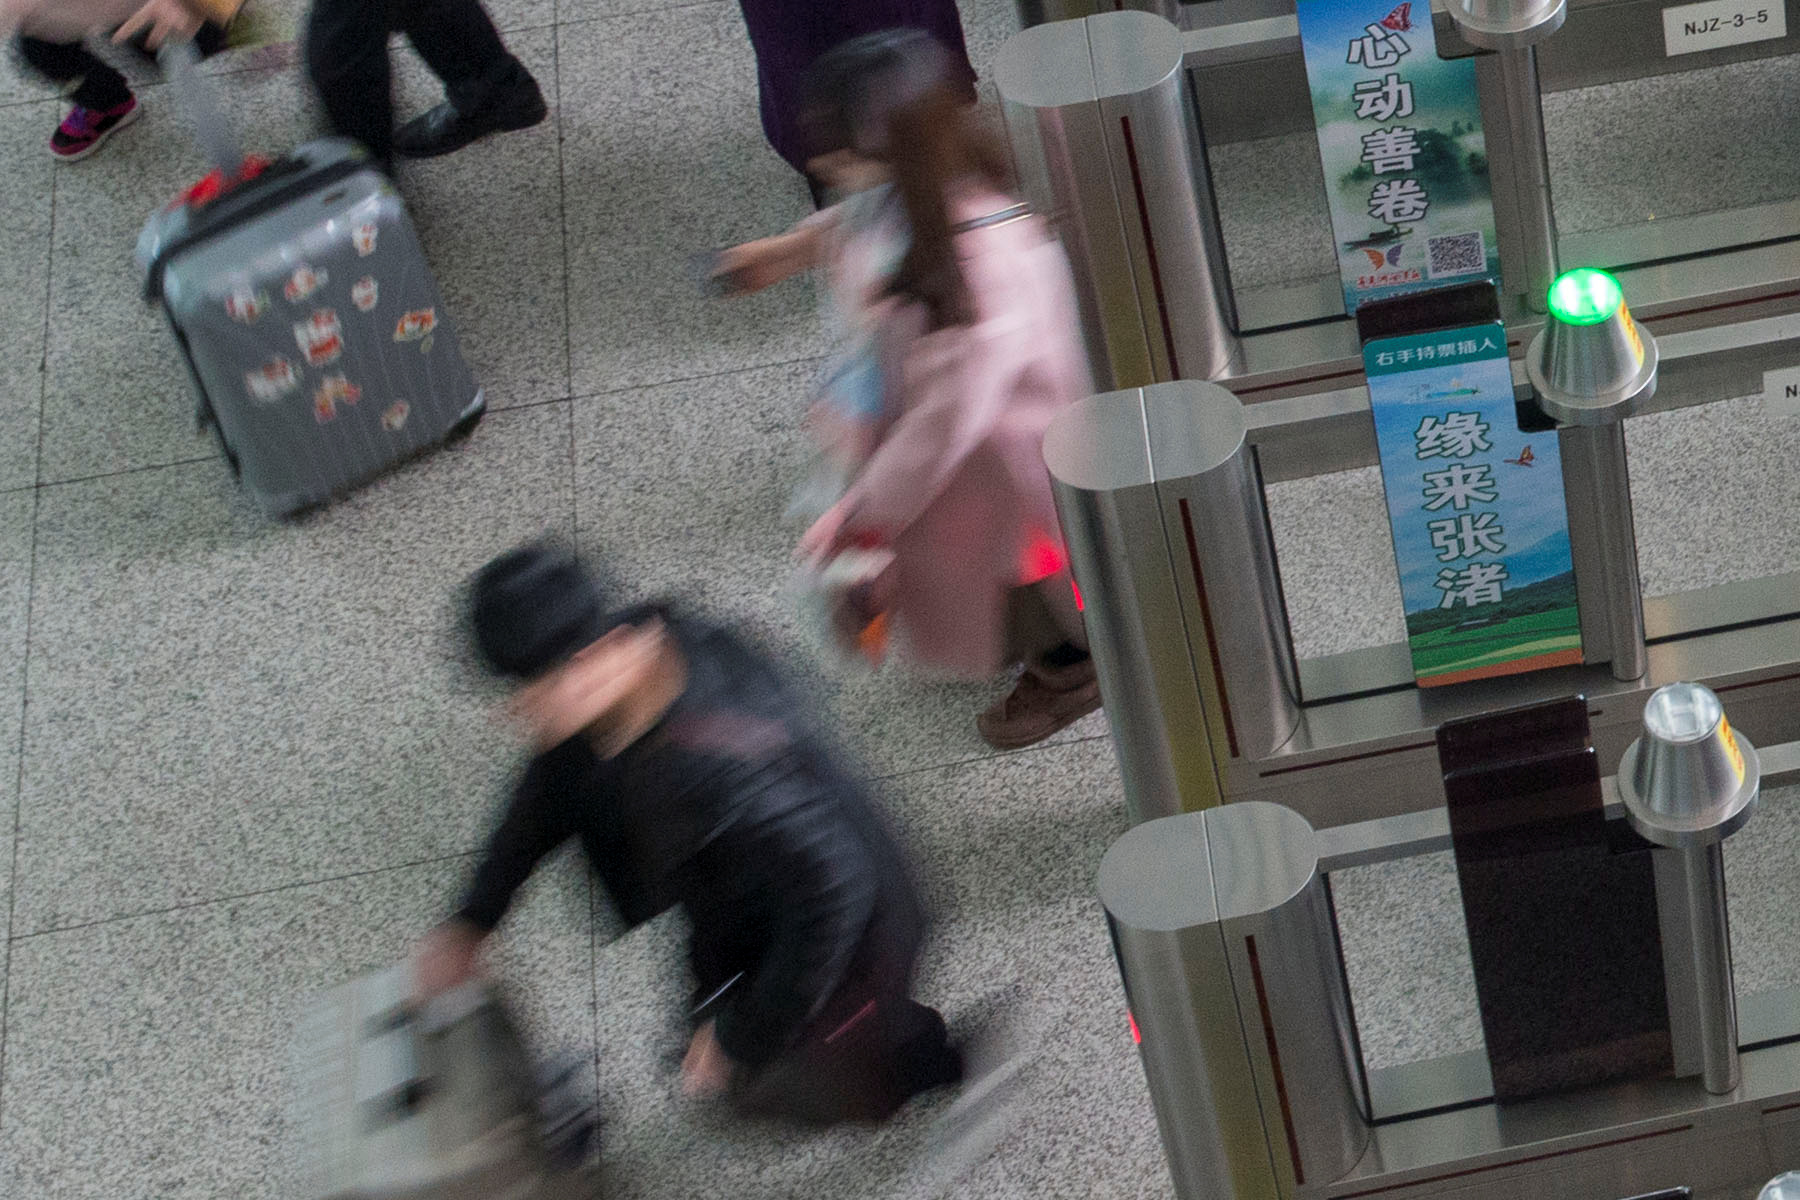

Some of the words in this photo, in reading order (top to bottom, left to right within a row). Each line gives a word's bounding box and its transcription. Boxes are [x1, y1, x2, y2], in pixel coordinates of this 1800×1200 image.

[1684, 8, 1768, 36] NJZ-3-5
[1346, 22, 1430, 225] 心动善卷
[1375, 337, 1498, 367] 右手持票插入
[1414, 411, 1510, 610] 缘来张渚
